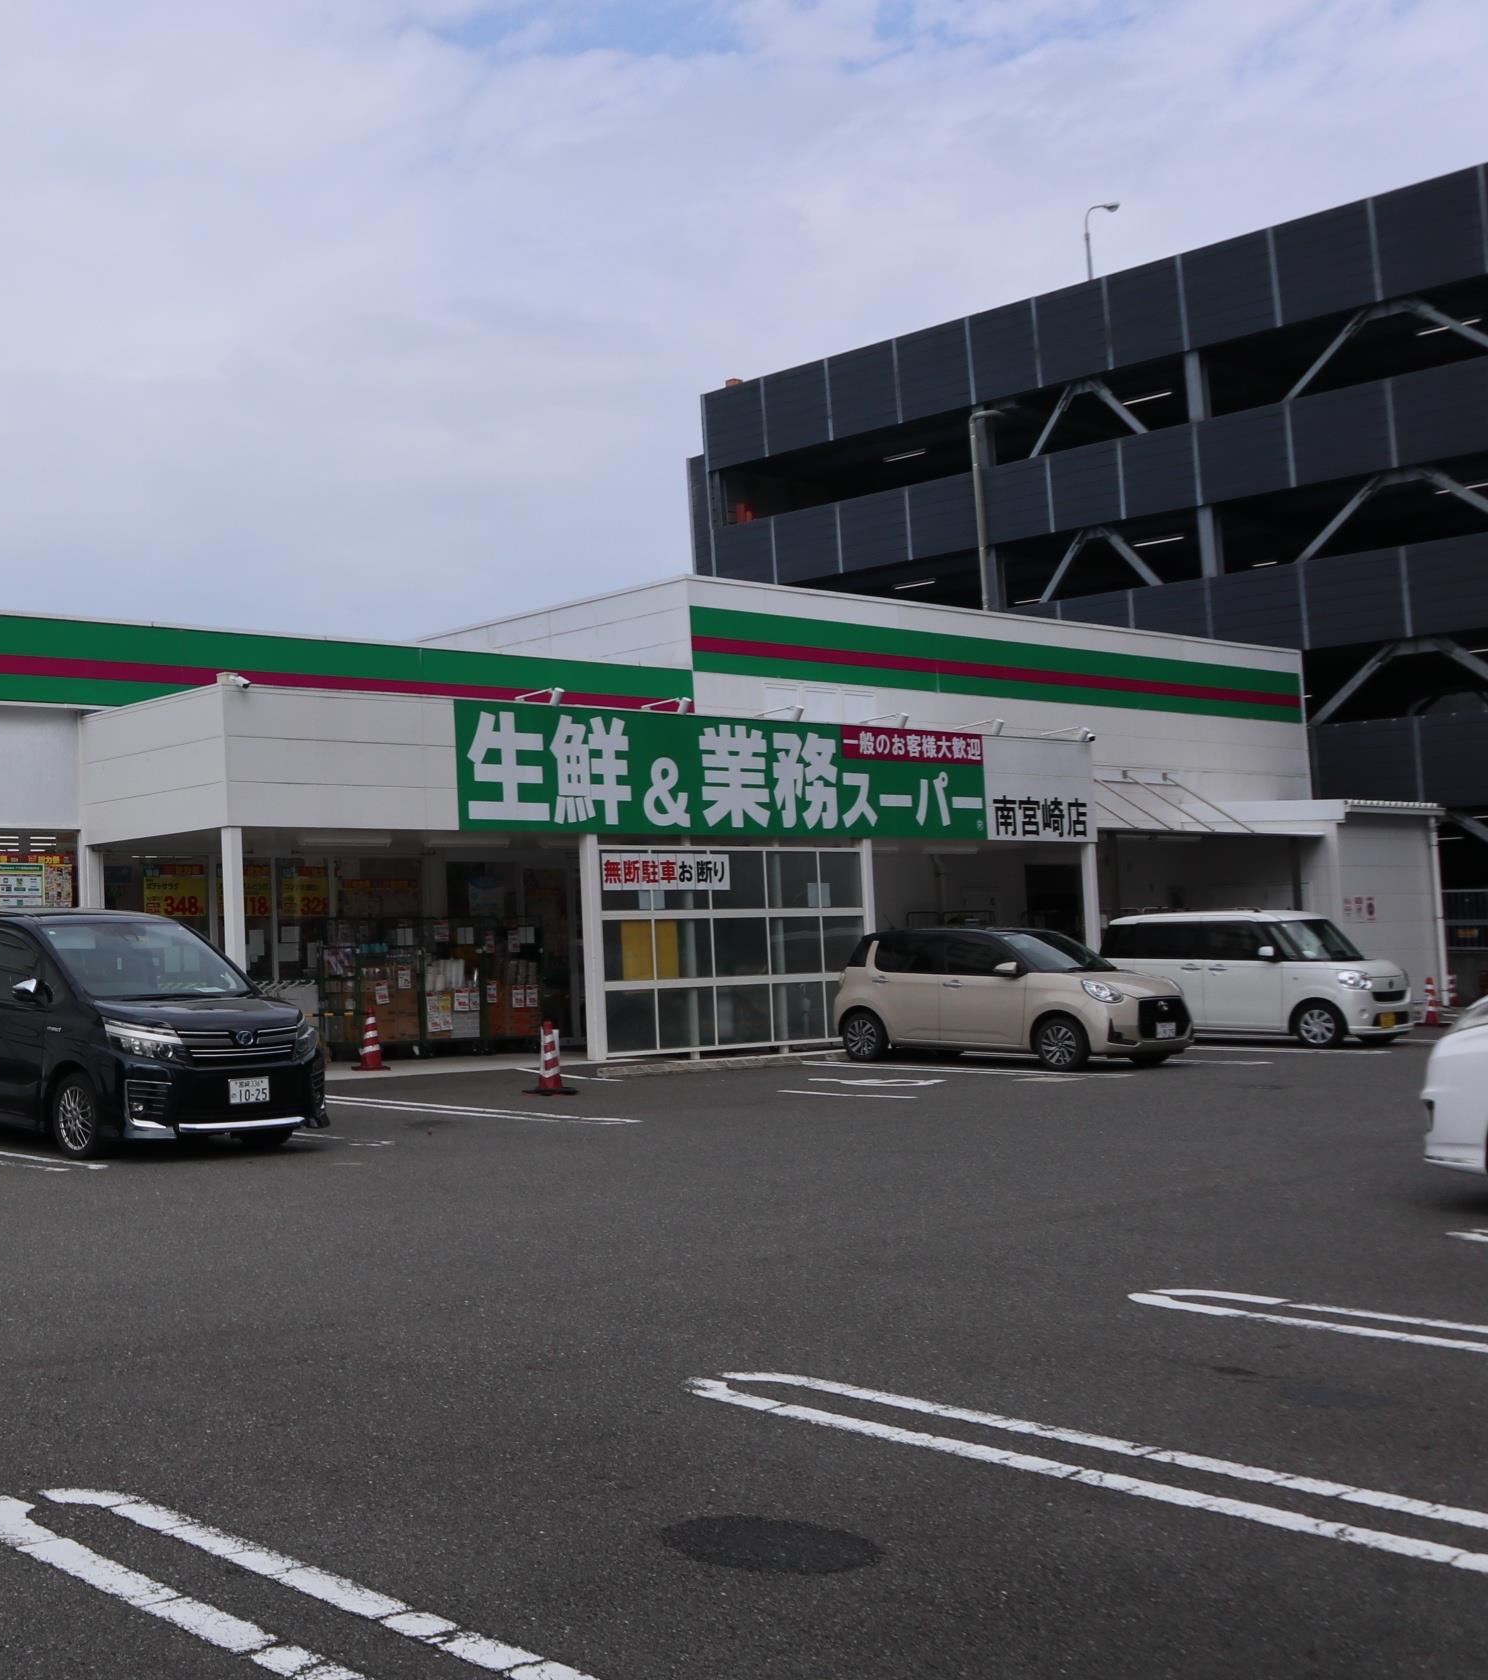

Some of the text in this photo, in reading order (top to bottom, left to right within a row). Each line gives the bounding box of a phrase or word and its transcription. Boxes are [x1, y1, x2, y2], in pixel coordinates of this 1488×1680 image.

[843, 733, 982, 761] 一般のお客様大歓迎
[992, 795, 1088, 838] 南宮崎店
[603, 859, 726, 885] 無断駐車お断り
[164, 895, 198, 916] 348
[239, 1088, 268, 1102] 10-25
